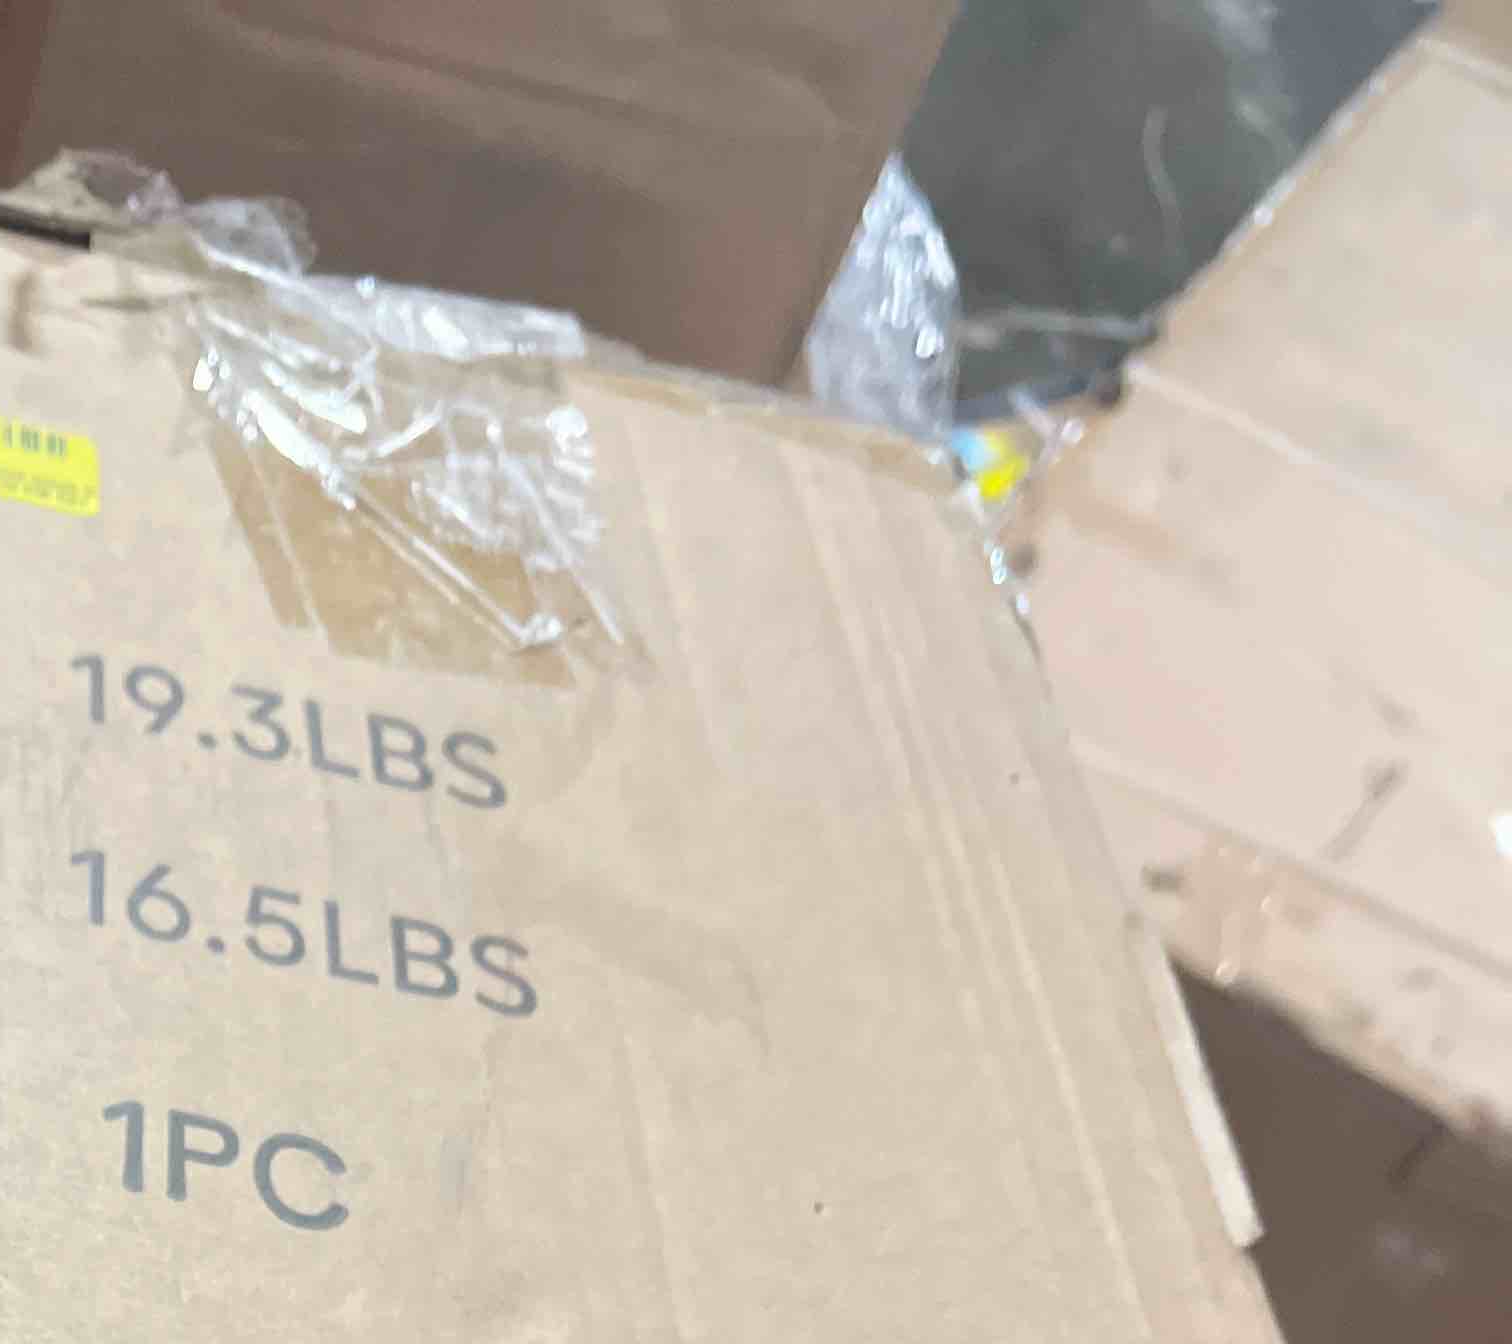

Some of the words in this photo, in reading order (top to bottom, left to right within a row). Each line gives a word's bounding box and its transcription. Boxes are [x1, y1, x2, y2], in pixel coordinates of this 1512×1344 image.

[71, 654, 508, 810] 19.3LBS
[70, 850, 540, 1019] 16.5LBS
[103, 1101, 351, 1231] 1PC
